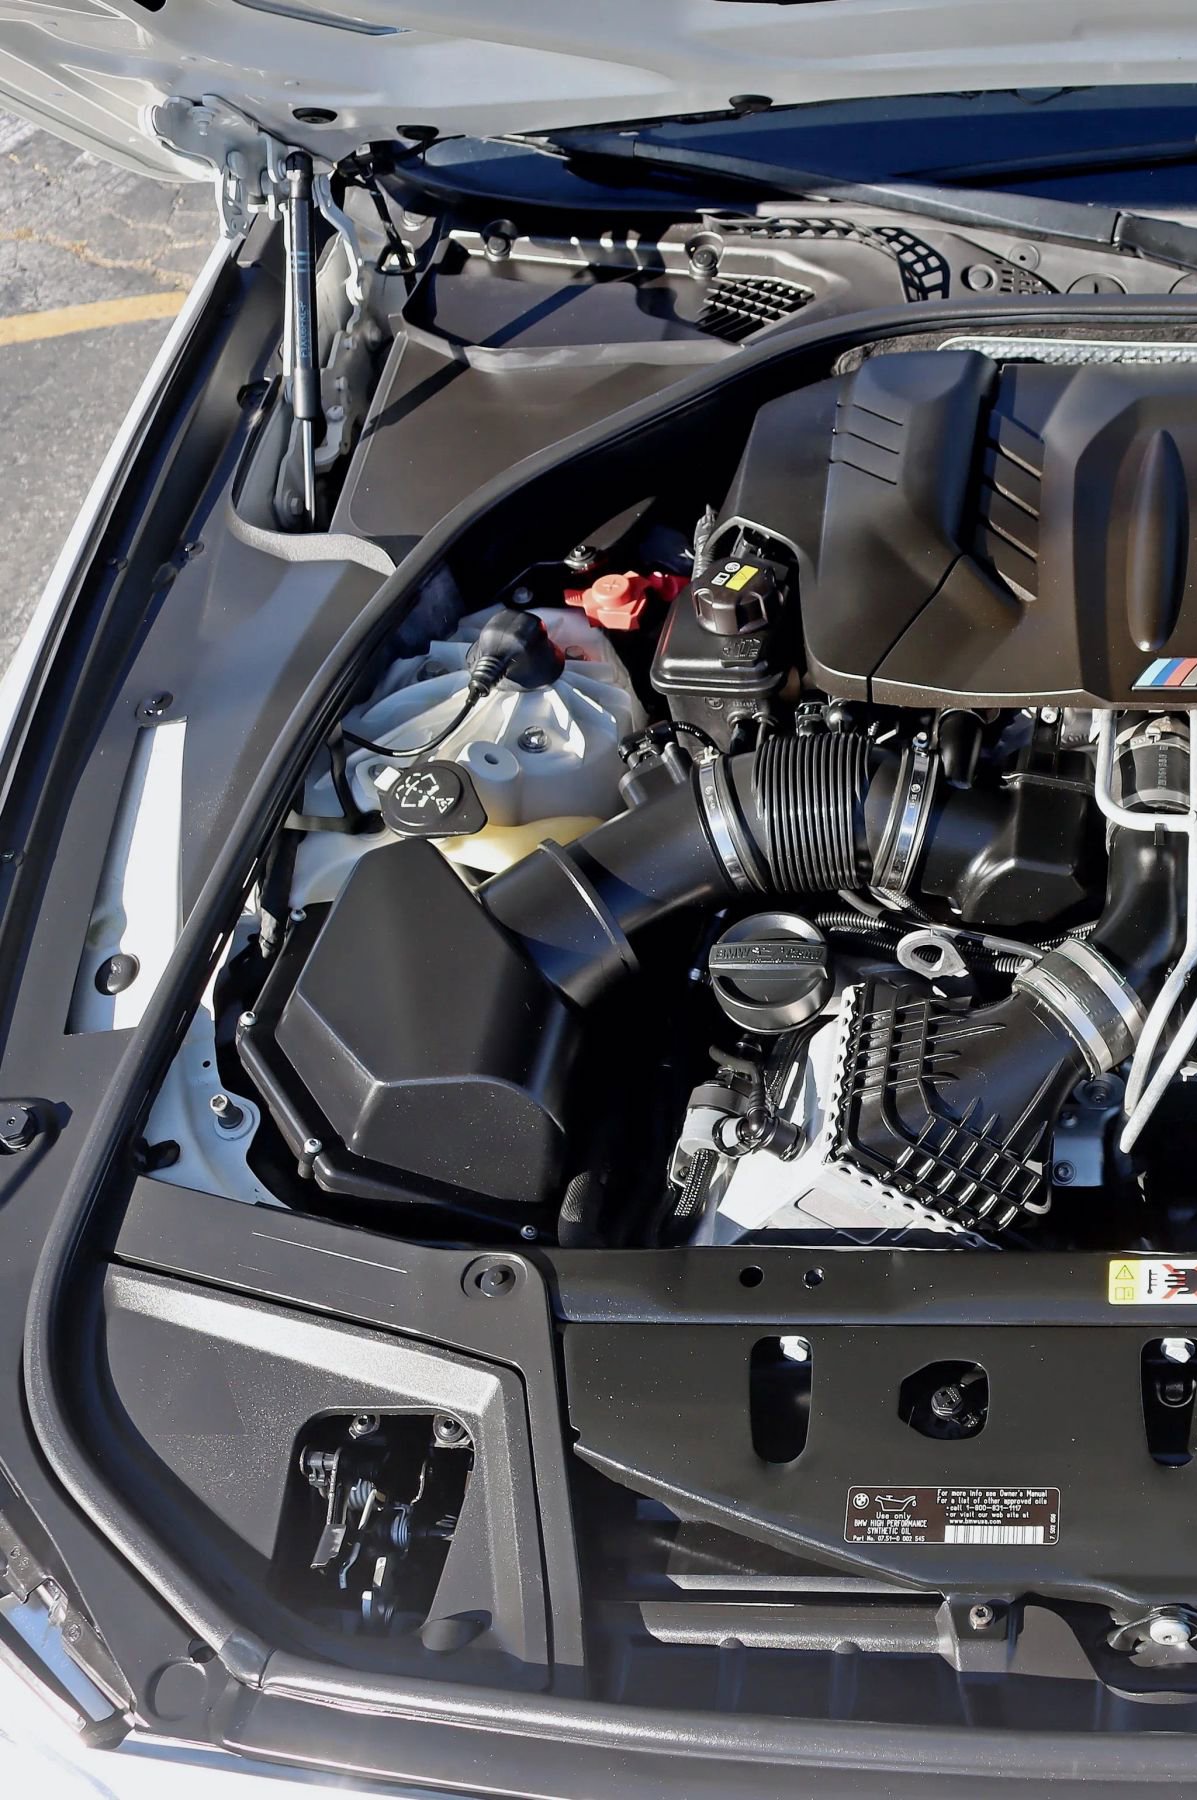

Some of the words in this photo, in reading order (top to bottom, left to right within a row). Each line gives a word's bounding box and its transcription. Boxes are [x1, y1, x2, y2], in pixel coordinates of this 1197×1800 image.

[937, 1488, 948, 1497] For
[1000, 1489, 1024, 1498] Owner's
[1026, 1489, 1048, 1498] Manual
[936, 1495, 948, 1504] For
[958, 1496, 970, 1505] list
[972, 1496, 981, 1504] of
[983, 1497, 1001, 1505] other
[1003, 1497, 1032, 1506] approved
[1034, 1497, 1048, 1505] oils
[875, 1511, 890, 1519] Use
[894, 1511, 912, 1521] only
[949, 1517, 1002, 1525] www.bmwusa.com
[853, 1518, 868, 1527] BMW
[870, 1519, 884, 1527] HIGH
[886, 1519, 928, 1528] PERFORMANCE
[866, 1526, 899, 1535] SYNTHETIC
[900, 1527, 912, 1535] OIL
